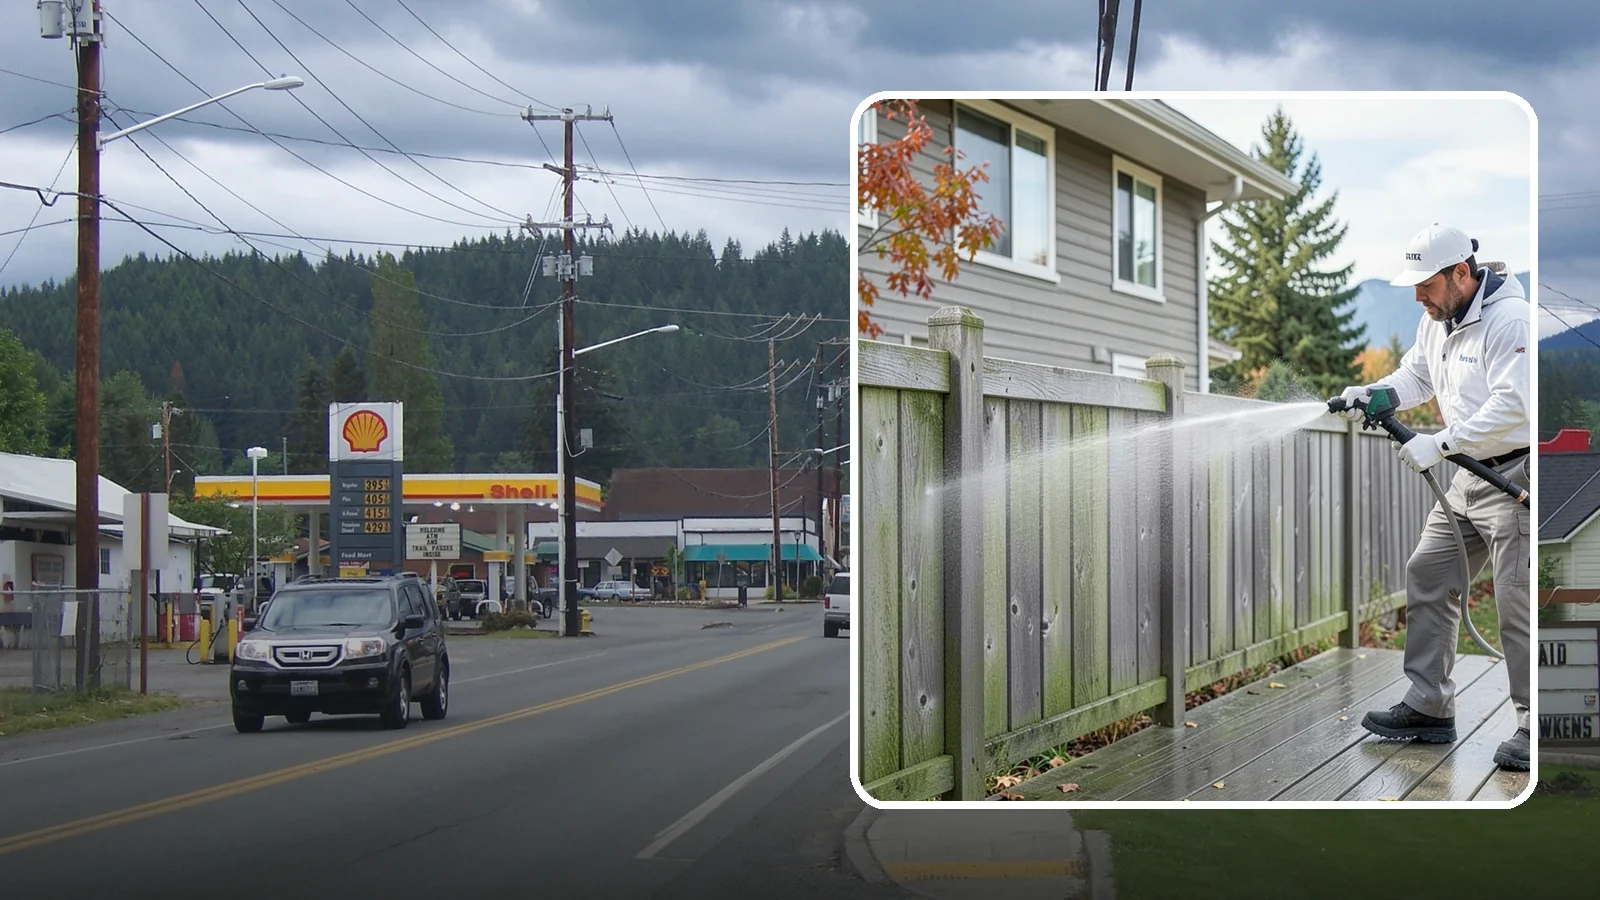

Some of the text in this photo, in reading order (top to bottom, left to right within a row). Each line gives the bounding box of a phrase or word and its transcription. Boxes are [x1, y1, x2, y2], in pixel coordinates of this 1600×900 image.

[366, 480, 383, 490] 395
[490, 484, 547, 499] Shell
[365, 494, 383, 504] 405
[365, 508, 383, 518] 415
[366, 522, 383, 532] 429
[1539, 643, 1567, 666] AID
